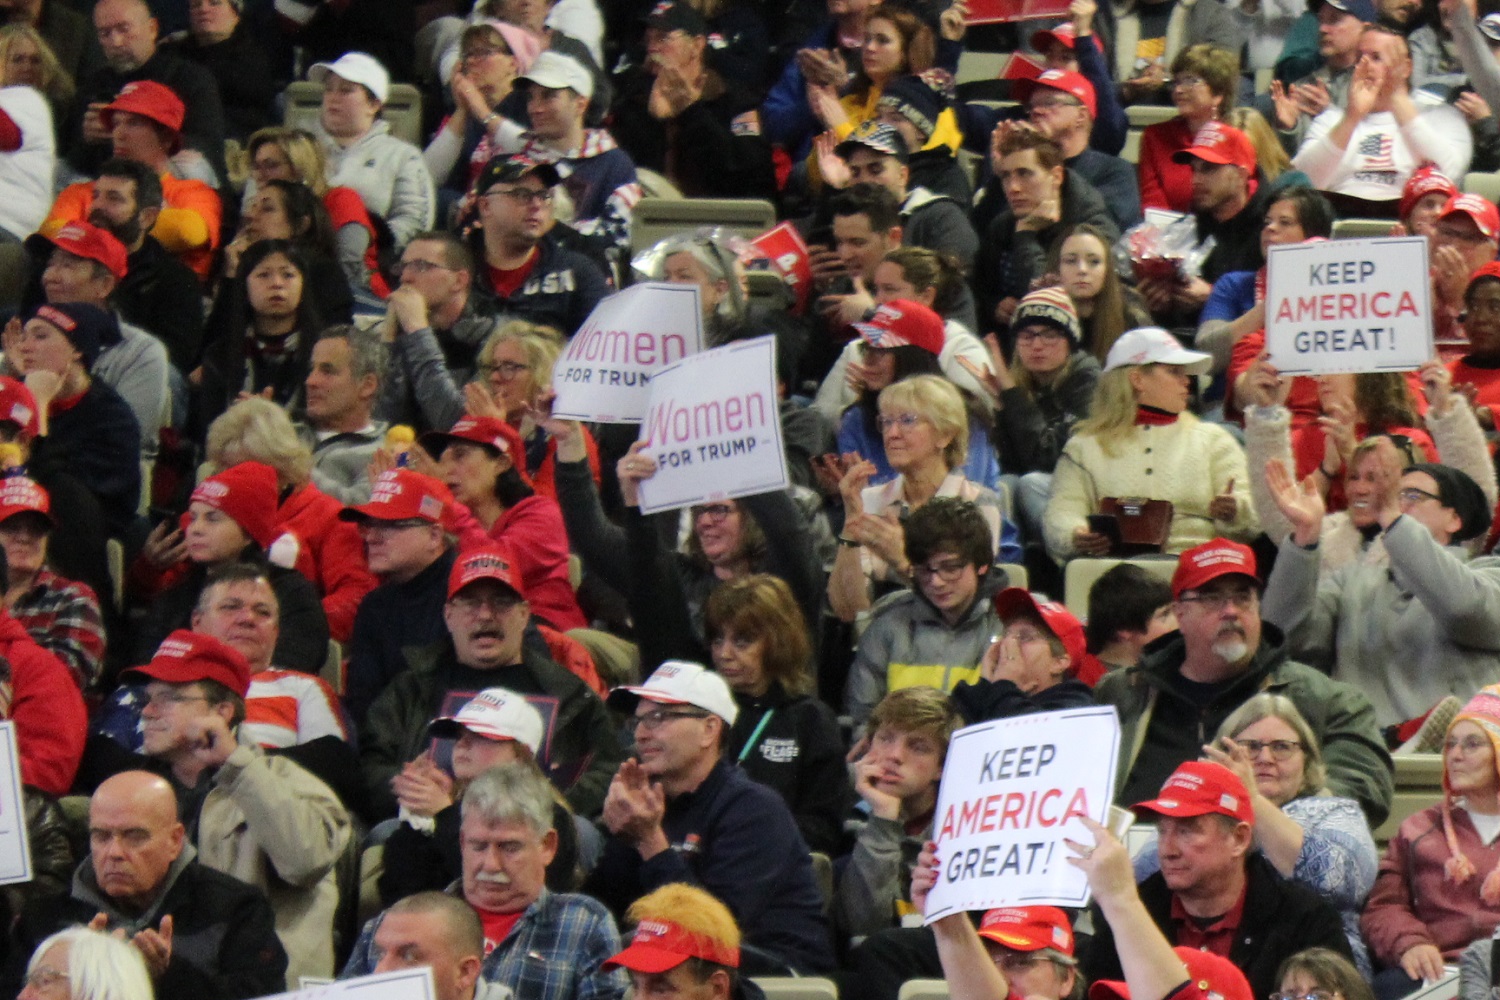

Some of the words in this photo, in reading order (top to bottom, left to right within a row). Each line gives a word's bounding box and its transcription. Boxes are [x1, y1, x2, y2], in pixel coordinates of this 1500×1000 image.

[1309, 261, 1376, 287] KEEP
[1275, 290, 1420, 325] AMERICA
[566, 325, 687, 363] Women
[1294, 327, 1397, 355] GREAT!
[564, 367, 595, 386] FOR
[599, 369, 652, 388] TRUM
[647, 390, 768, 447] Women
[659, 450, 694, 470] FOR
[697, 438, 759, 465] TRUMP
[978, 742, 1057, 786] KEEP
[940, 785, 1091, 843] AMERICA
[945, 837, 1055, 889] GREAT!
